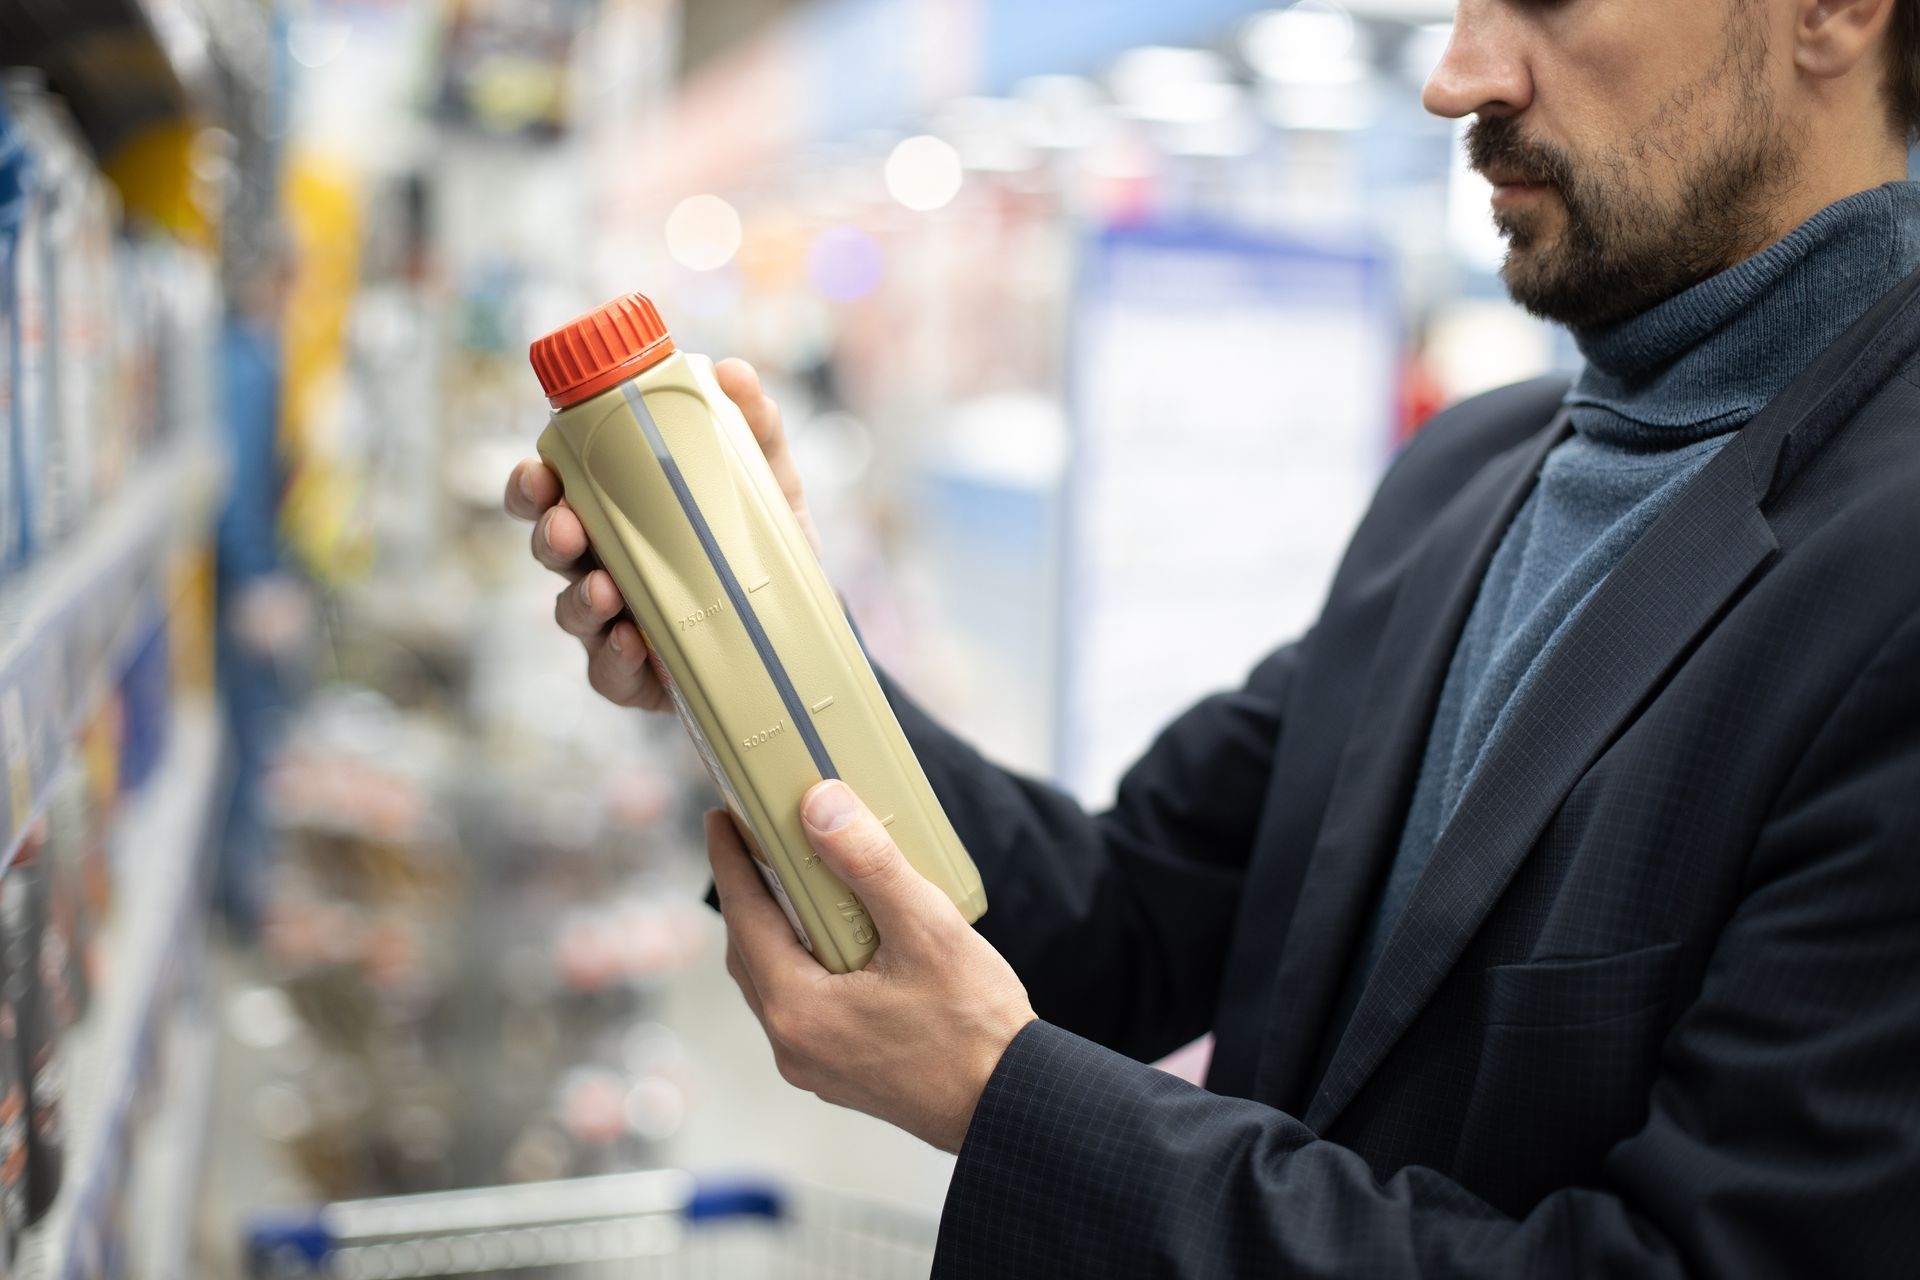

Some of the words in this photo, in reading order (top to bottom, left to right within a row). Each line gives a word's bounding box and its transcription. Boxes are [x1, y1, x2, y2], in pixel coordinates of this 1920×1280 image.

[678, 599, 723, 632] 750ml
[742, 719, 784, 752] 500ml
[803, 850, 822, 872] 25
